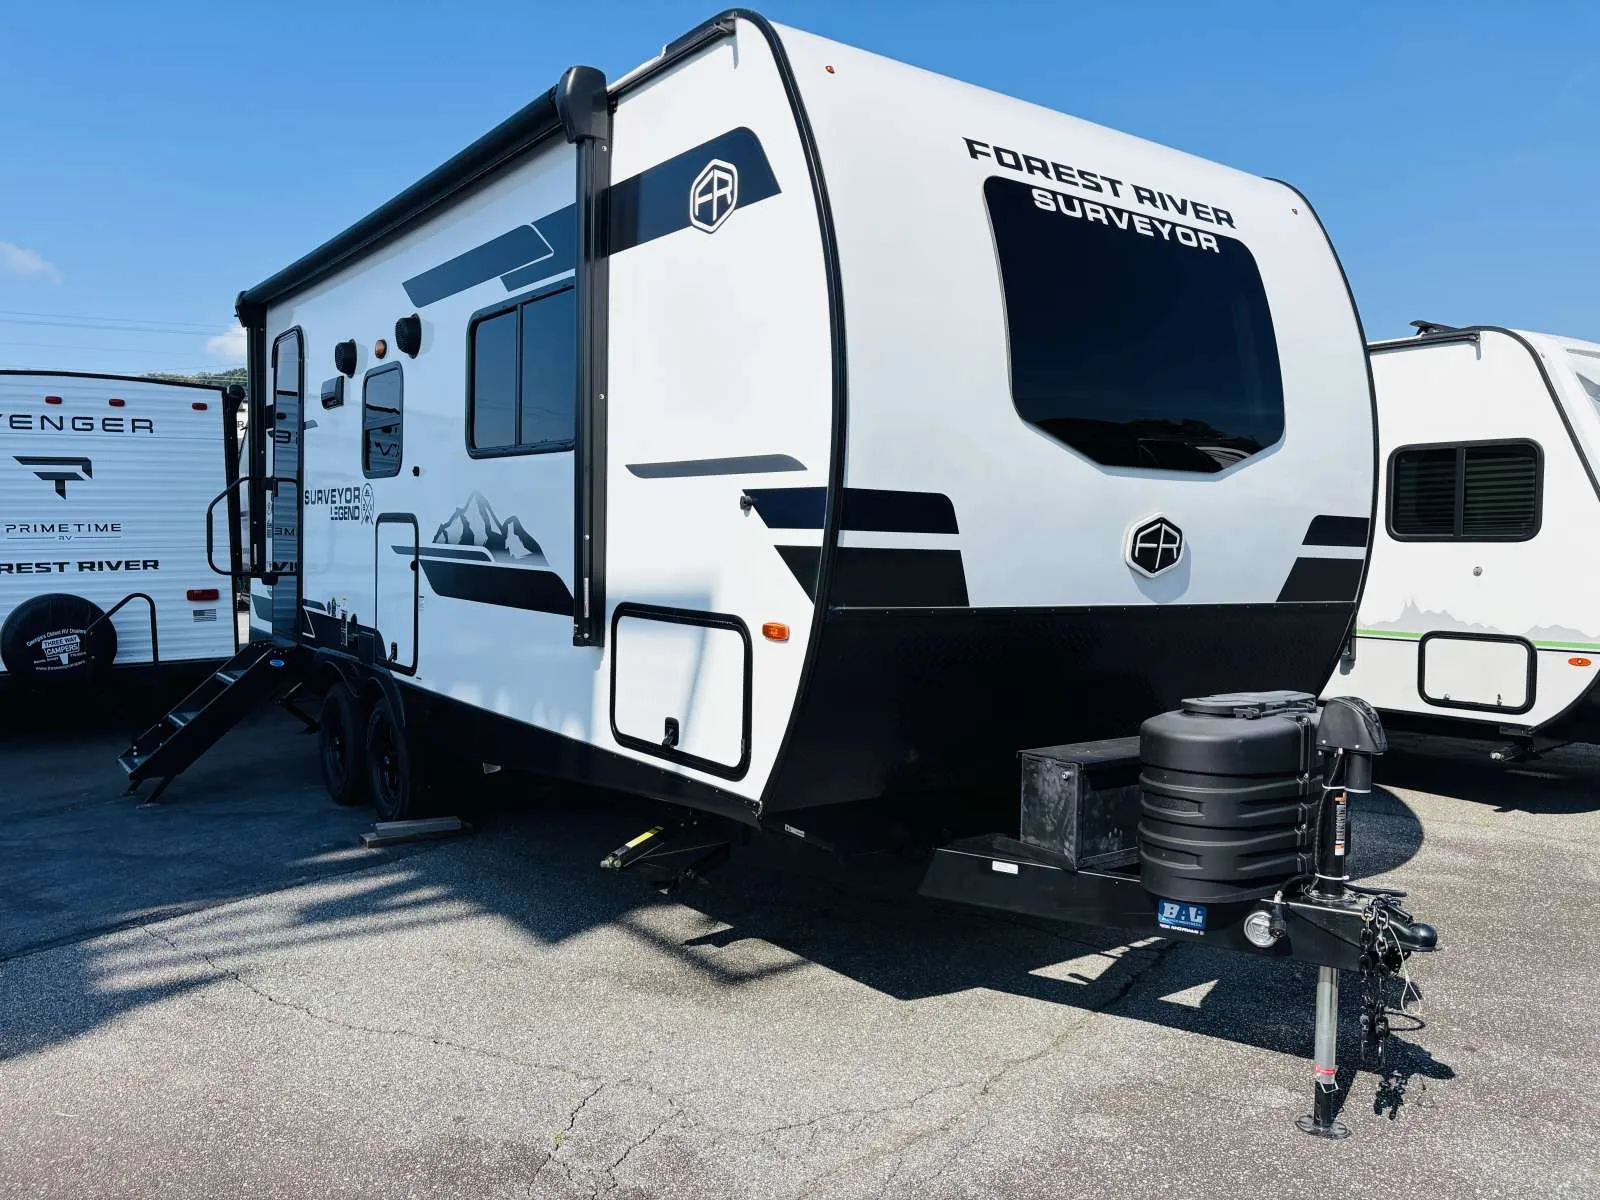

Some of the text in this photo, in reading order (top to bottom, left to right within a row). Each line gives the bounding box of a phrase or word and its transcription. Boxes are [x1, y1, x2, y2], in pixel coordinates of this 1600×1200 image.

[962, 137, 1237, 229] FOREST RIVER
[1032, 189, 1219, 253] SURVEYOR
[0, 414, 153, 434] ENGER
[304, 487, 360, 505] SURVEYOR
[330, 505, 360, 520] LEGEND
[77, 560, 160, 572] RIVER
[44, 636, 78, 648] THREE WAY
[46, 643, 78, 656] CAMPERS
